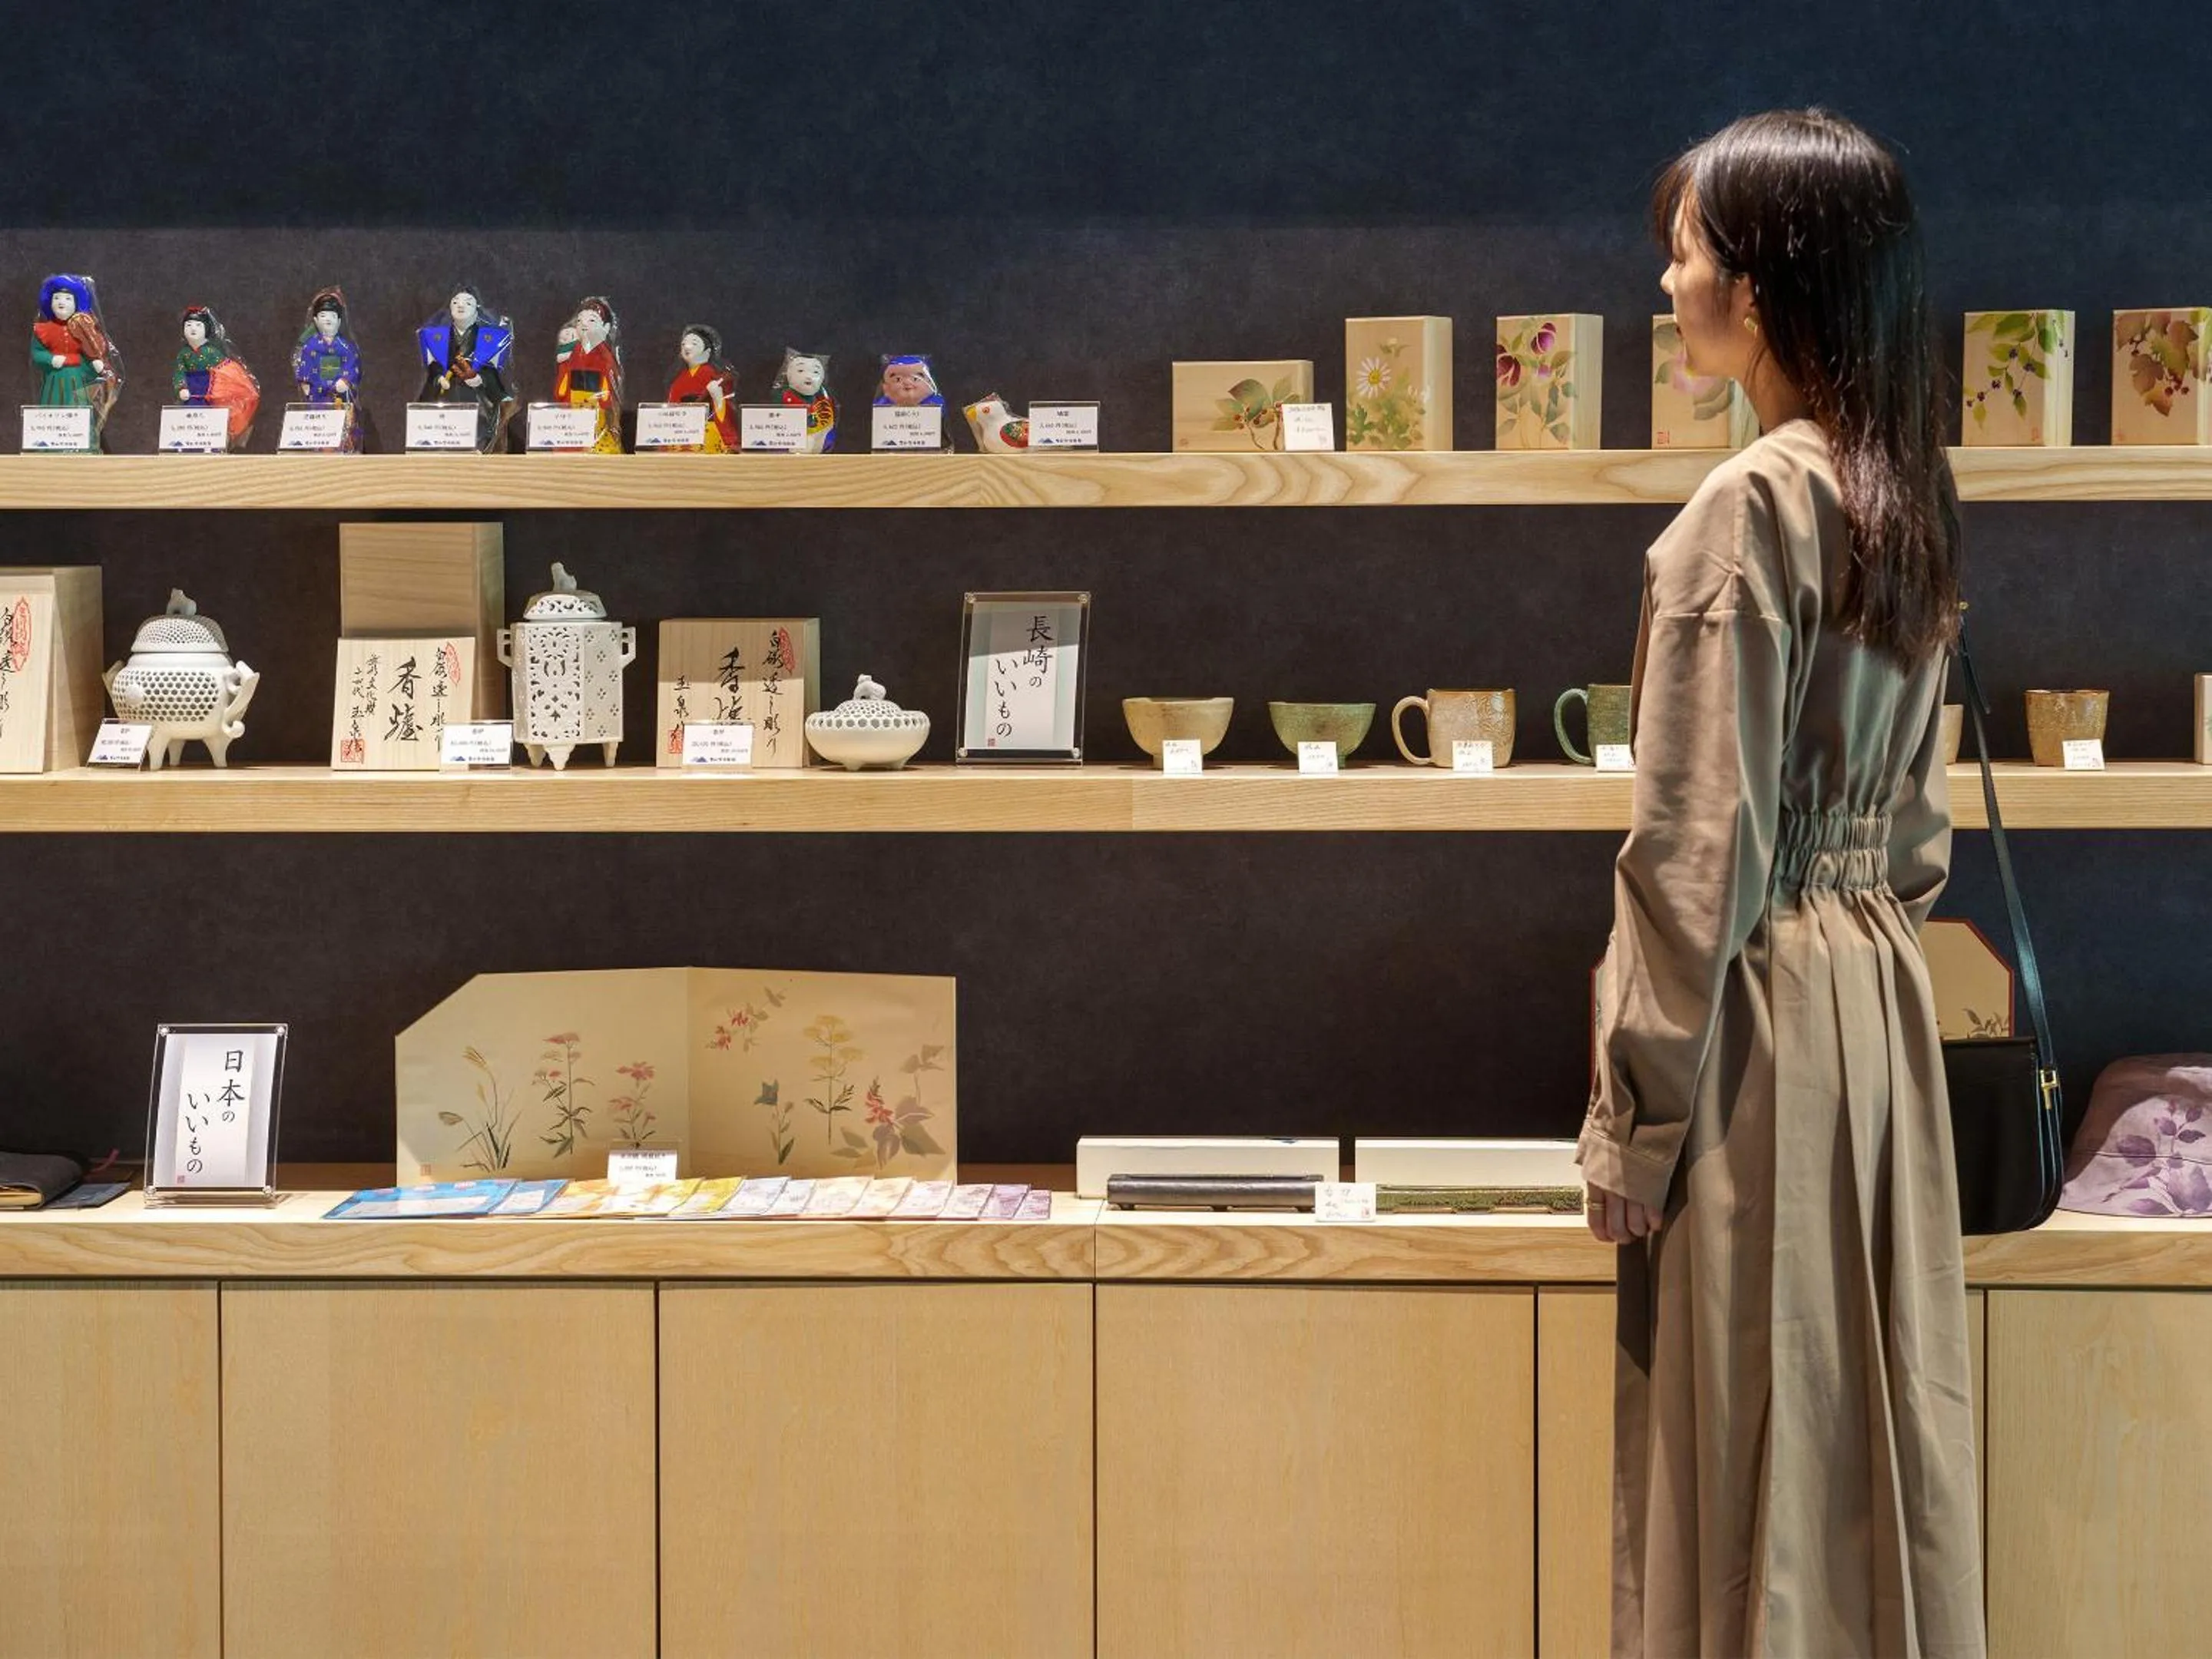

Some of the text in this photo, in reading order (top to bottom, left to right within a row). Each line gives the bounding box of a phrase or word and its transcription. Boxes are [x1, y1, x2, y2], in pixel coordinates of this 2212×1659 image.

[1022, 615, 1055, 688] 長崎の
[994, 659, 1019, 737] いいもの
[216, 1049, 246, 1123] 日本の
[184, 1093, 210, 1174] いいもの
